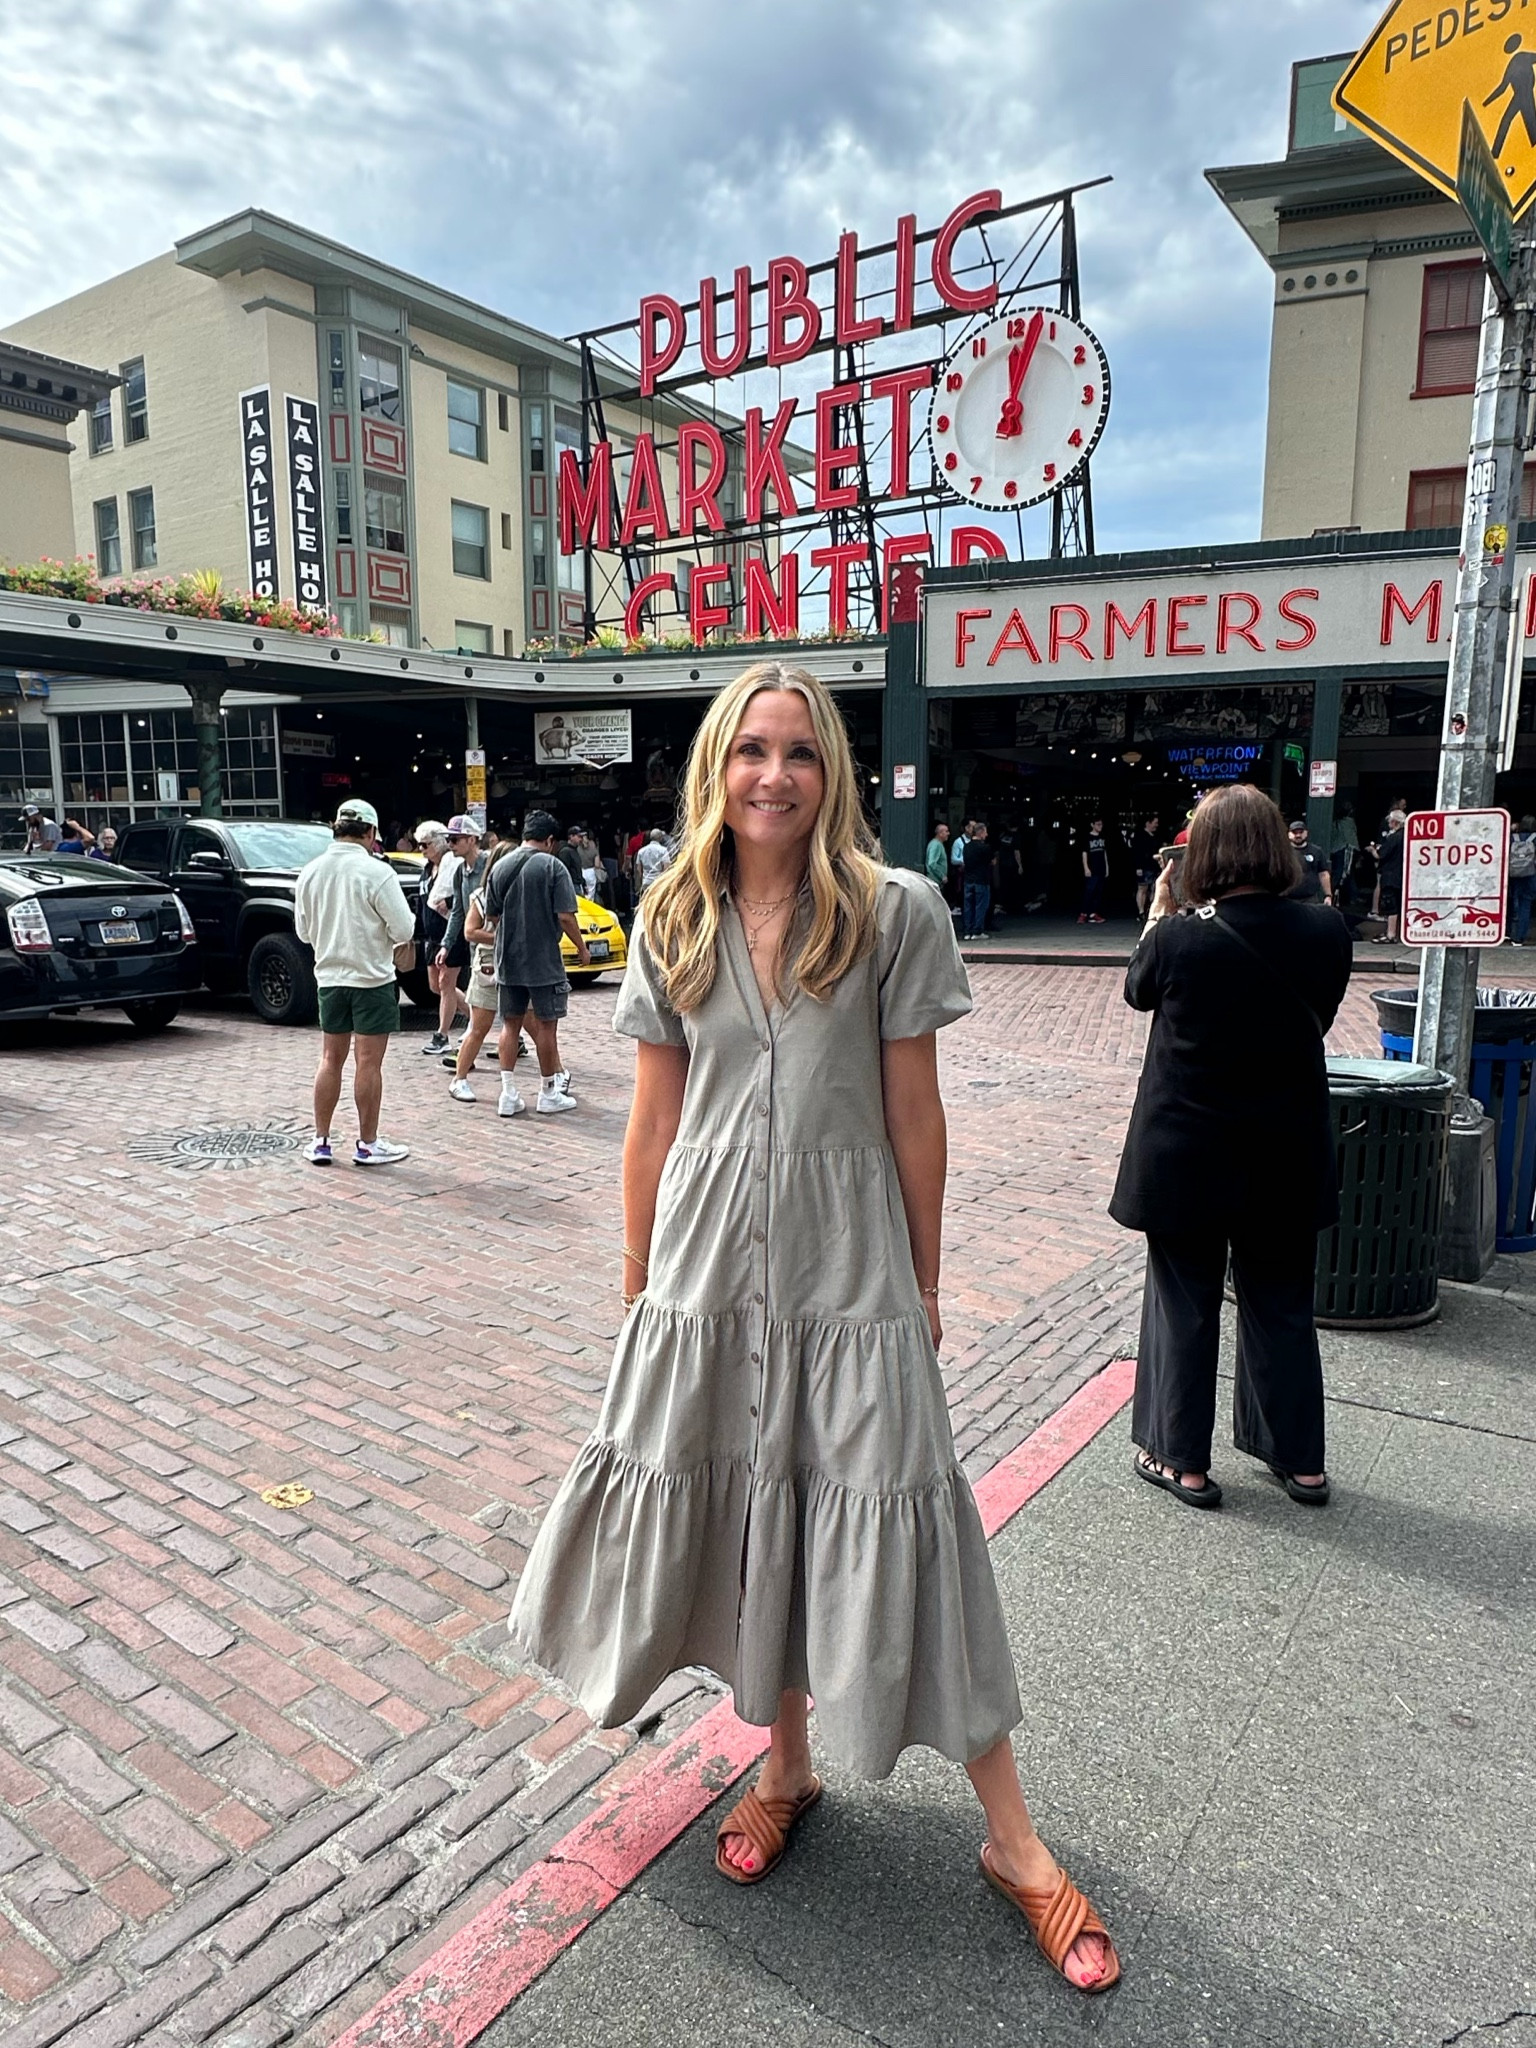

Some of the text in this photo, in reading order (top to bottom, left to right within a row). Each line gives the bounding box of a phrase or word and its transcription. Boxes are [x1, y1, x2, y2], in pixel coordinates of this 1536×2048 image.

[1385, 0, 1528, 75] PEDES
[640, 189, 1002, 397] PUBLIC
[1007, 318, 1025, 339] 12
[1050, 321, 1056, 341] 1
[972, 337, 986, 358] 11
[1074, 345, 1086, 365] 2
[946, 373, 963, 392] 10
[1081, 384, 1094, 405] 3
[246, 400, 266, 440] LA
[292, 402, 314, 445] LA
[937, 415, 950, 433] 9
[1068, 429, 1083, 447] 4
[560, 366, 933, 555] MARKET
[944, 452, 958, 471] 8
[1043, 463, 1056, 482] 5
[970, 476, 982, 495] 7
[1004, 481, 1017, 499] 6
[249, 445, 271, 547] SALLE
[294, 453, 317, 552] SALLE
[955, 588, 1320, 667] FARMERS
[1168, 744, 1264, 762] WATERFRONT
[1180, 762, 1251, 775] VIEWPOINT
[1412, 819, 1439, 837] NO
[1418, 844, 1494, 866] STOPS
